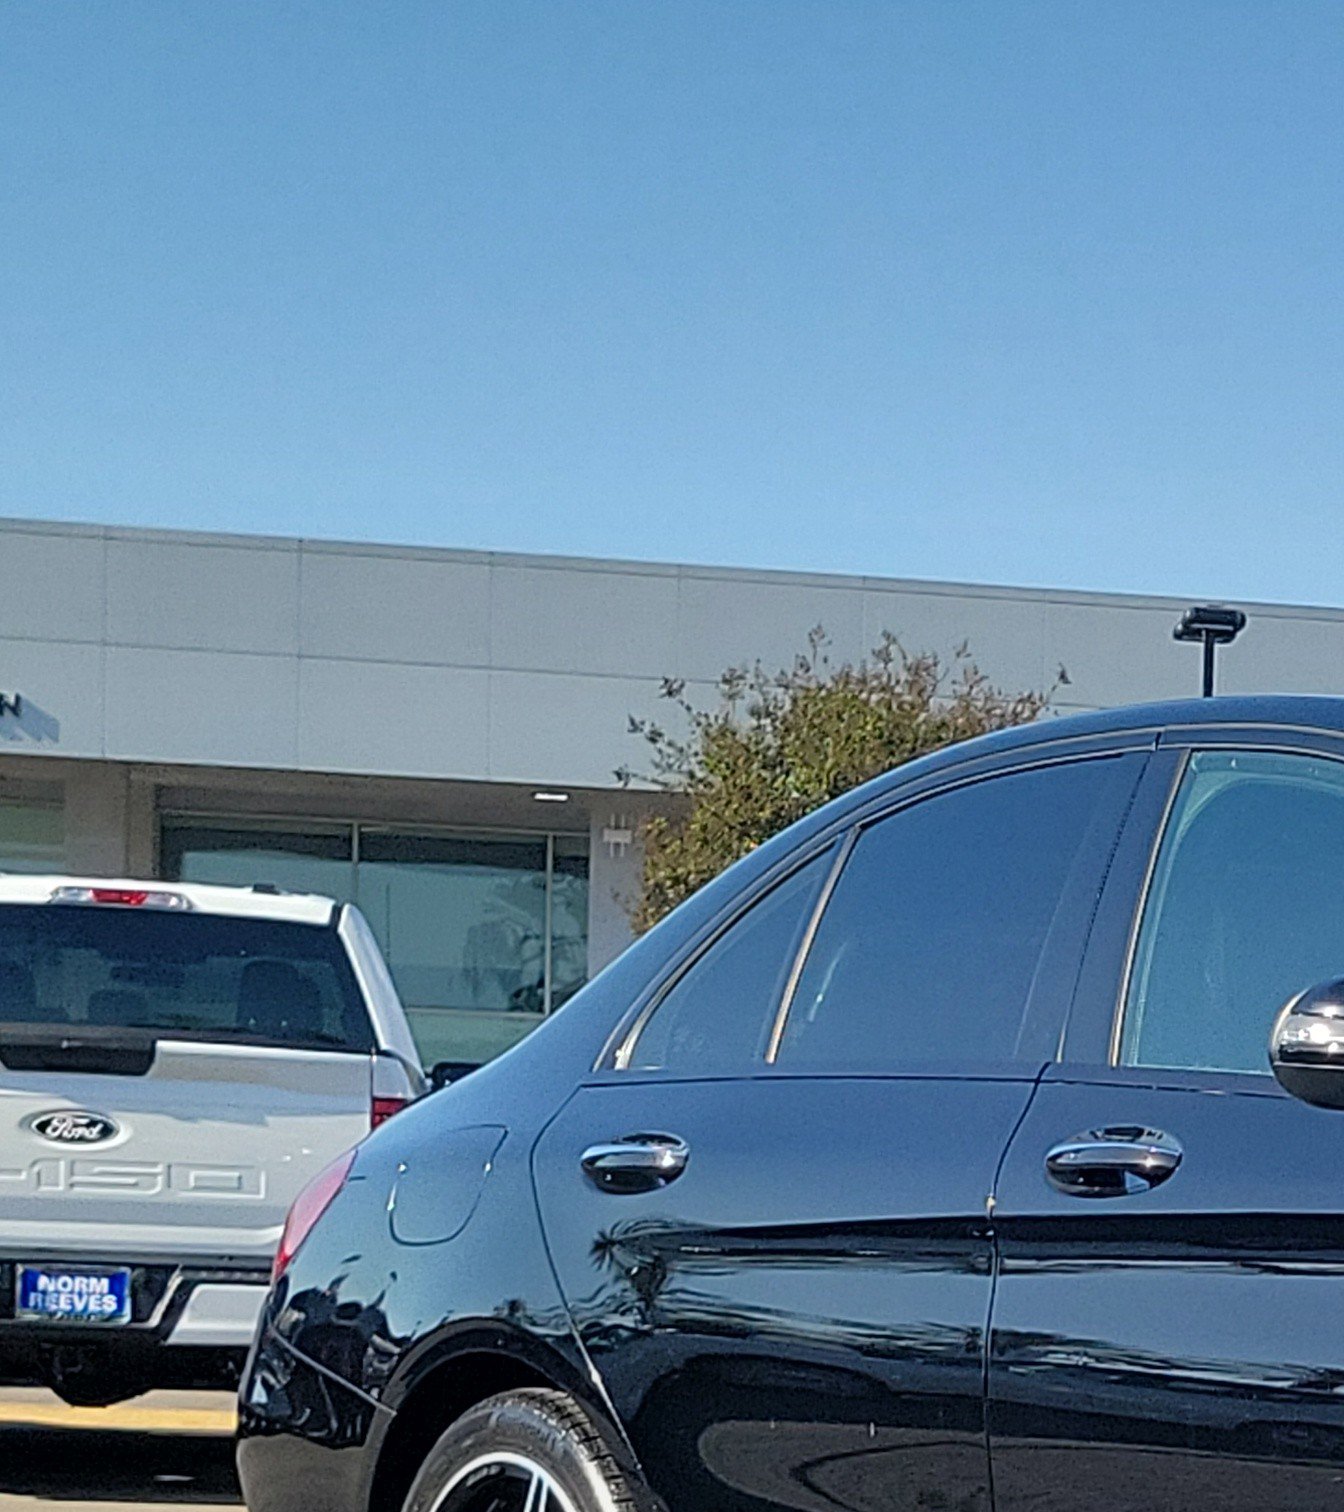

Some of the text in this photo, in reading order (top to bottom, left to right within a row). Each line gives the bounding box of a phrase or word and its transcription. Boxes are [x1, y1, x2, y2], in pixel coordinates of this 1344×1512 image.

[45, 1114, 102, 1140] Ford
[37, 1274, 110, 1295] NORM
[28, 1292, 118, 1313] REEVES
